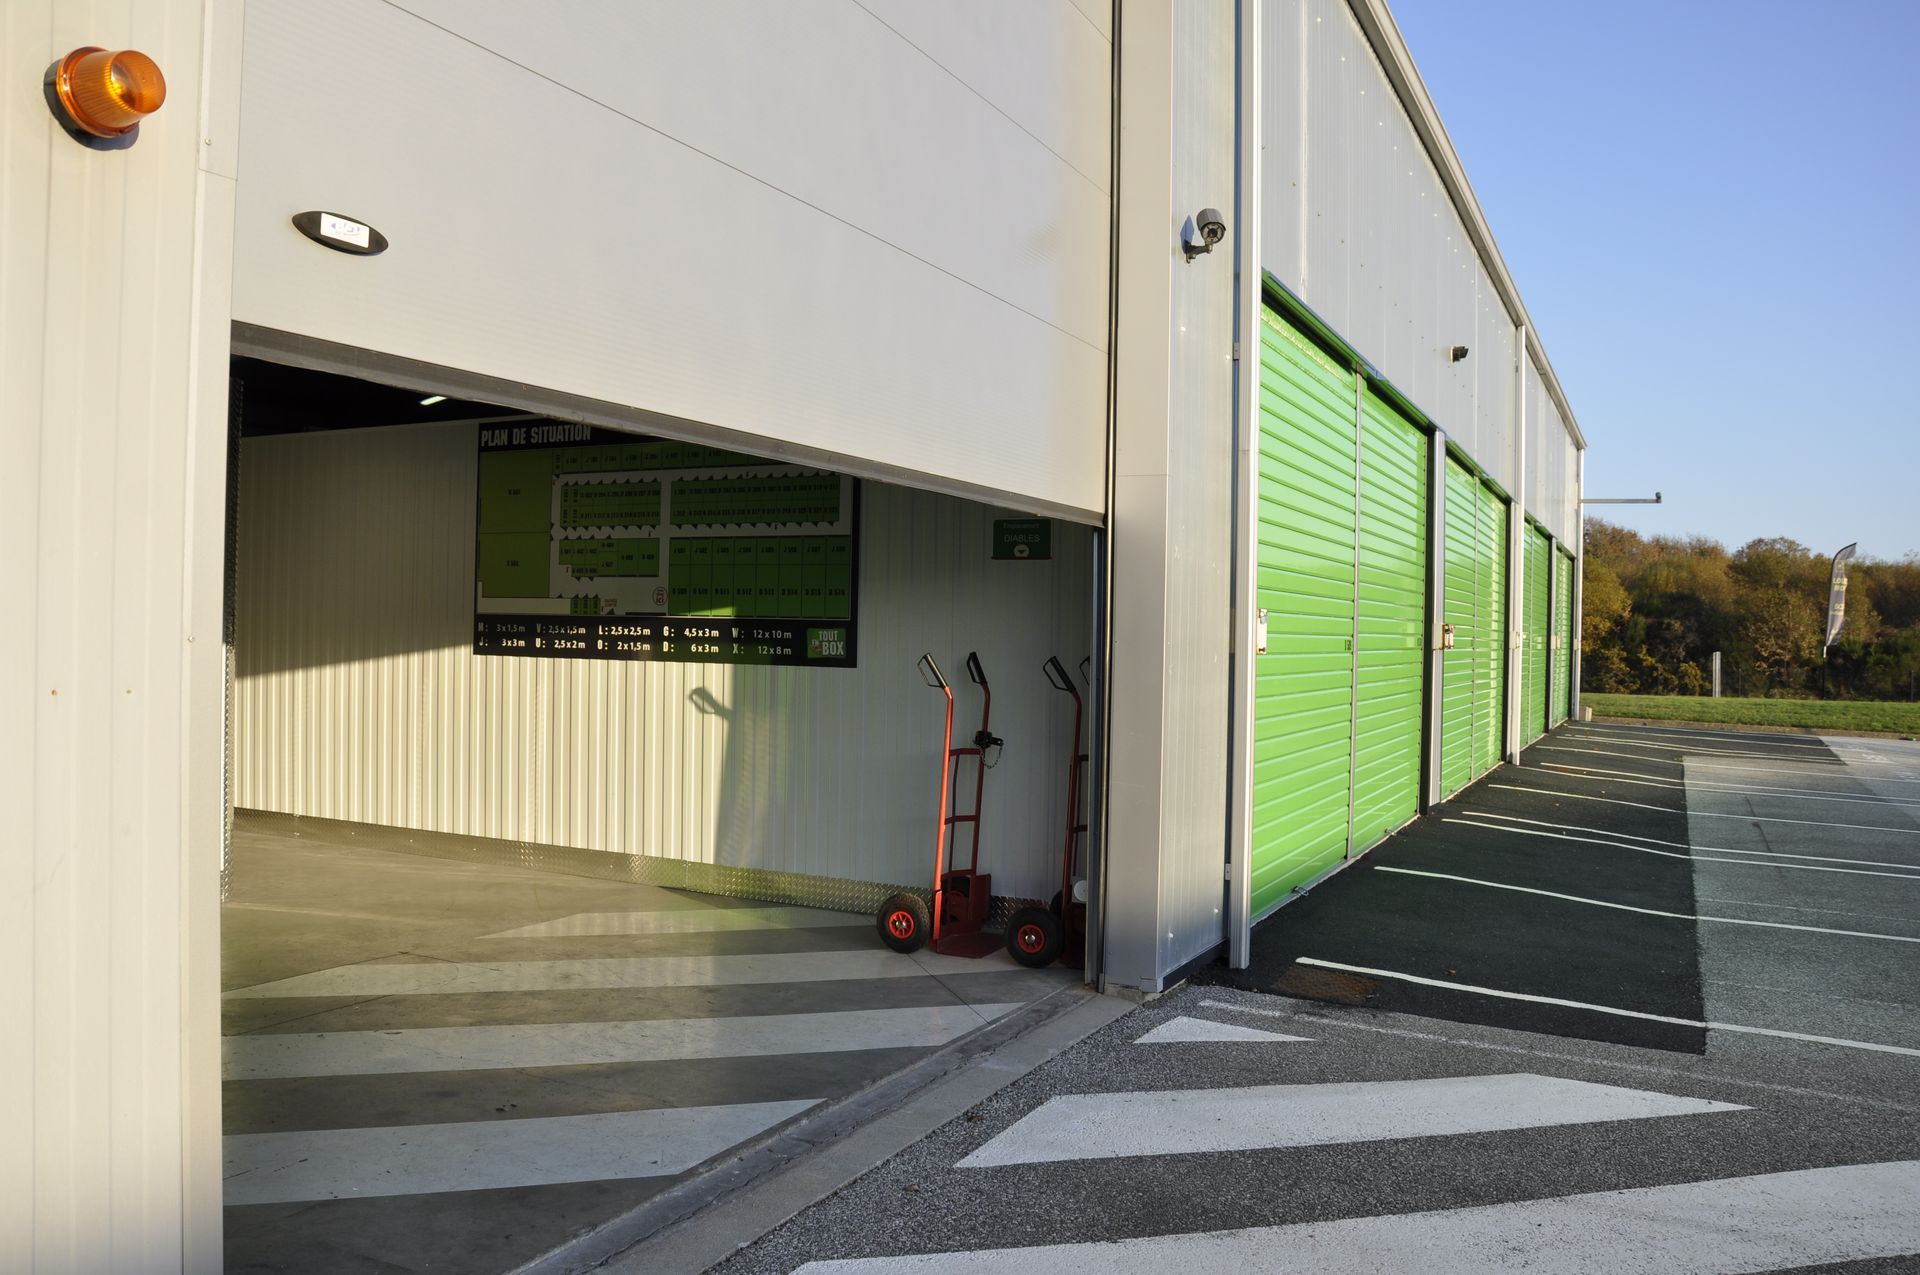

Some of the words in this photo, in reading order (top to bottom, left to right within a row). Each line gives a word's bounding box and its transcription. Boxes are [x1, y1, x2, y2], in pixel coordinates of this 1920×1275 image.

[481, 429, 508, 447] PLAN
[513, 427, 527, 446] DE
[531, 424, 591, 444] SITUATION
[1003, 533, 1041, 544] DIABLES
[598, 624, 608, 635] L:
[731, 627, 744, 639] W:
[818, 630, 839, 641] TOUT
[732, 643, 744, 654] X:
[822, 641, 844, 656] BOX
